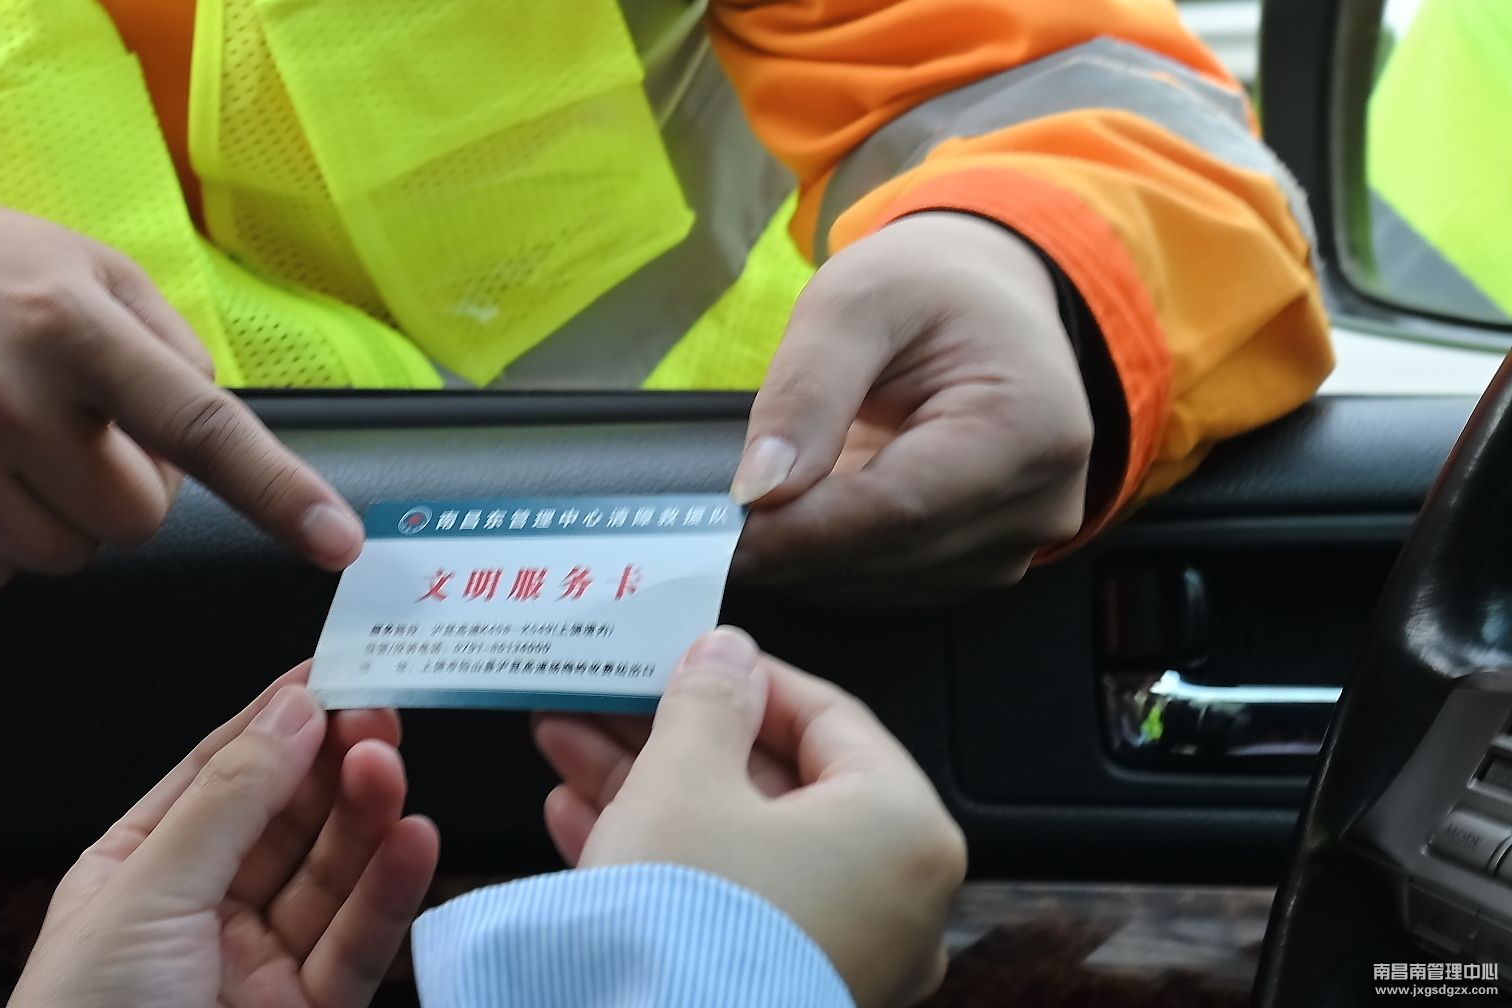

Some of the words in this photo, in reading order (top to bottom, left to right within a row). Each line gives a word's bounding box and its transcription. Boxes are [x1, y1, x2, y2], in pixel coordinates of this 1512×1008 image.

[414, 563, 644, 601] 文明服务卡
